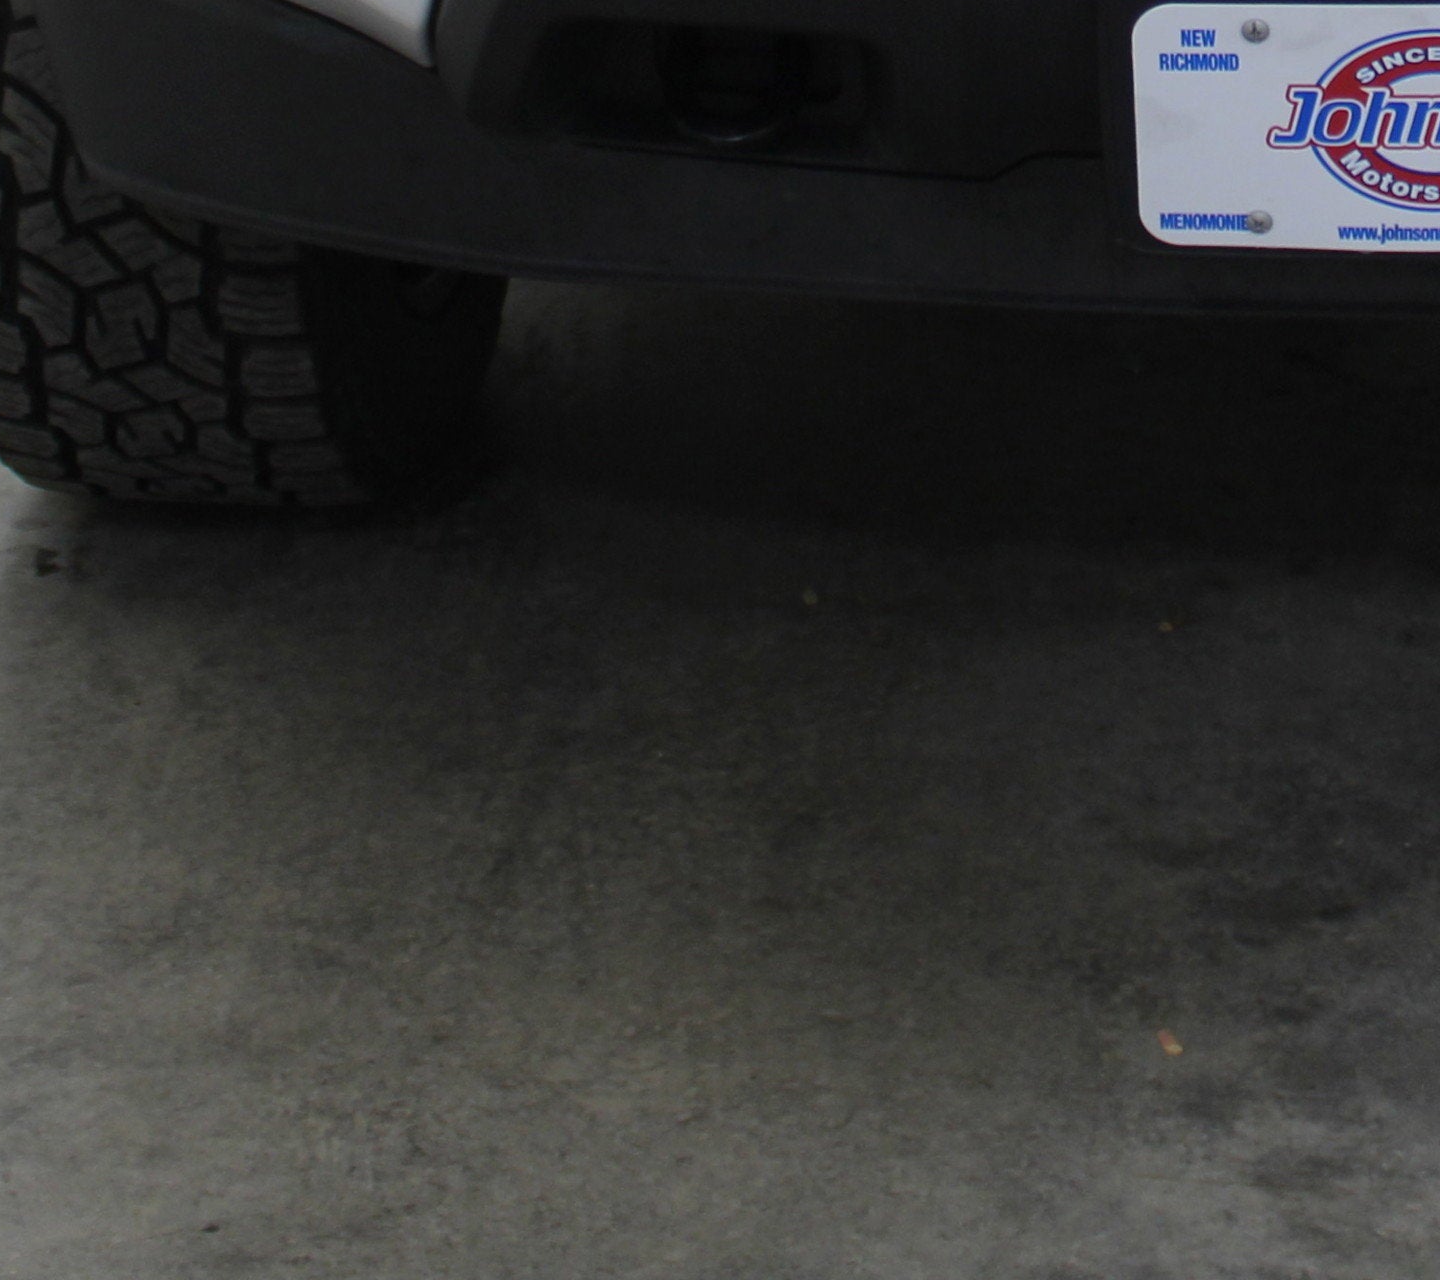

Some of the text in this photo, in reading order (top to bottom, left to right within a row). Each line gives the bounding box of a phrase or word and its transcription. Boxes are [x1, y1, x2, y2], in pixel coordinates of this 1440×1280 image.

[1180, 29, 1215, 47] NEW
[1160, 53, 1239, 71] RICHMOND
[1339, 149, 1440, 202] Motors
[1160, 213, 1250, 231] MENOMONIE
